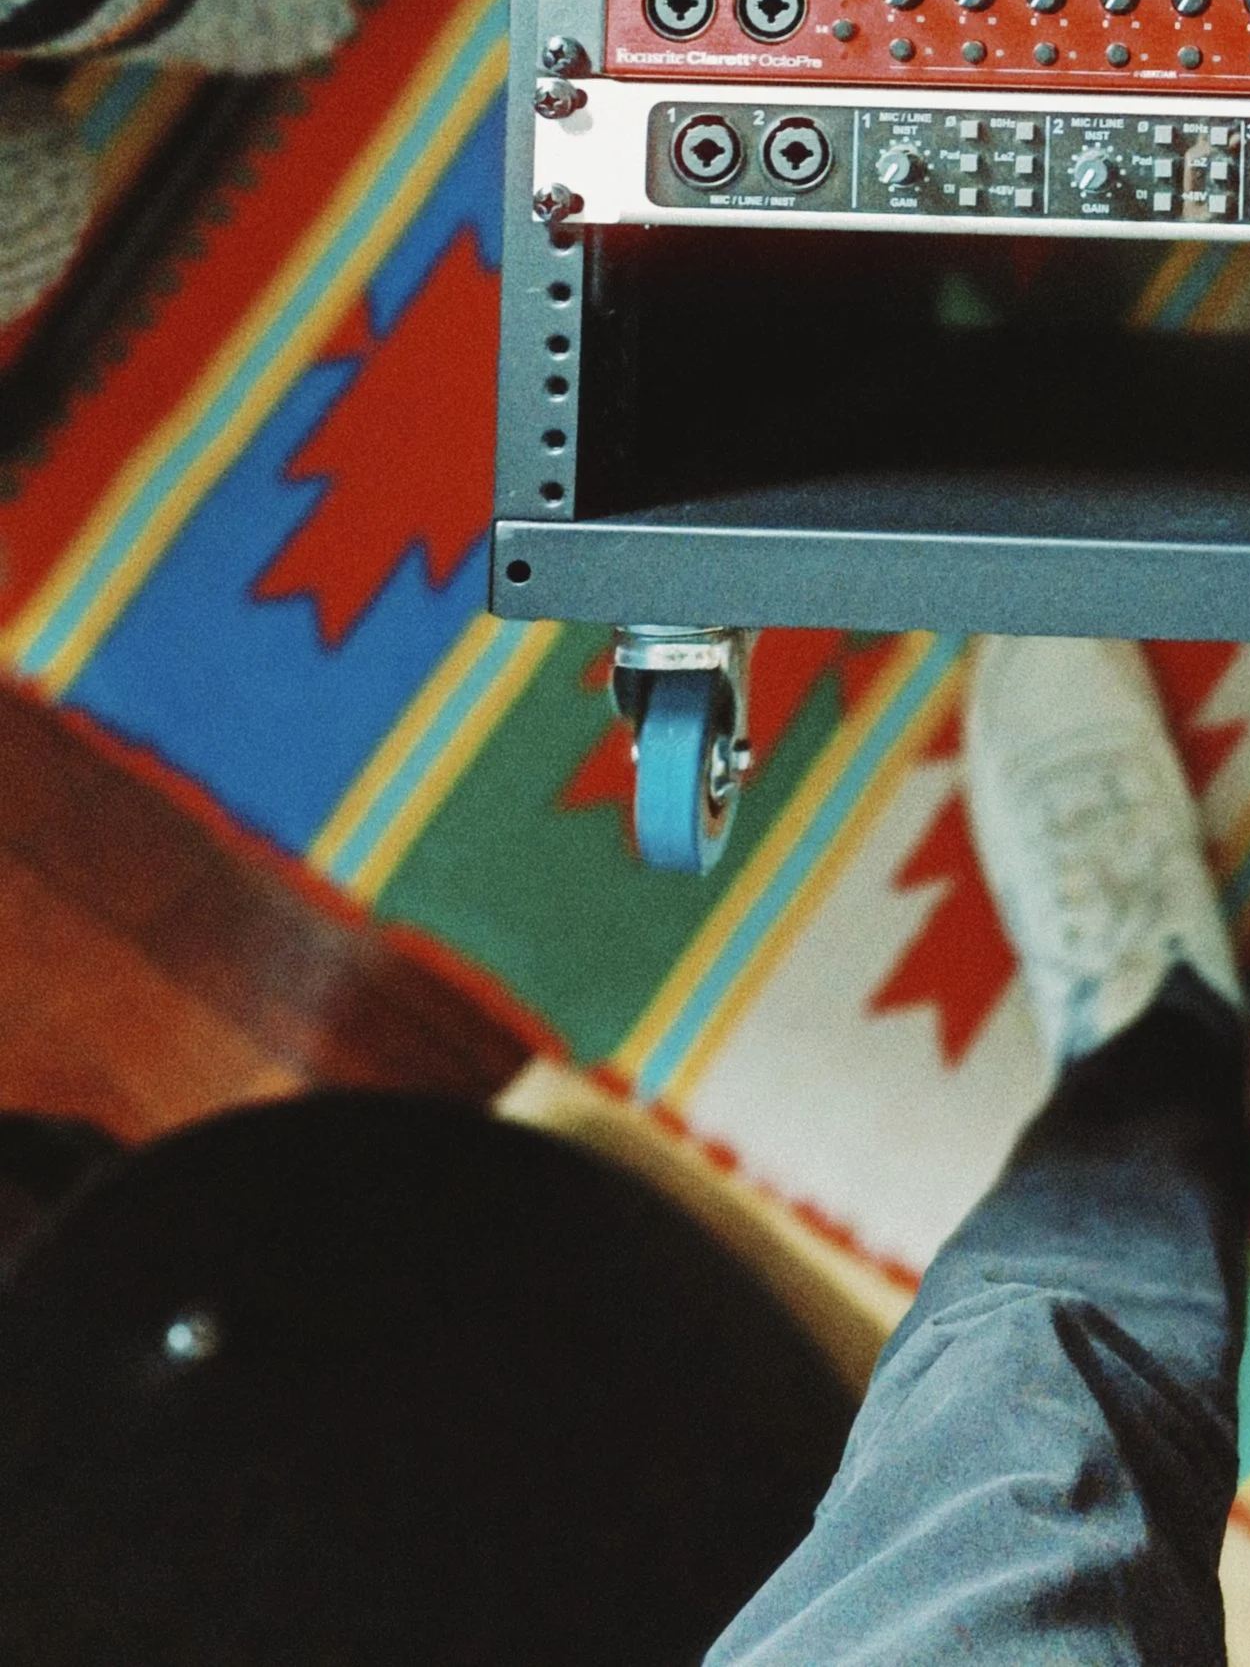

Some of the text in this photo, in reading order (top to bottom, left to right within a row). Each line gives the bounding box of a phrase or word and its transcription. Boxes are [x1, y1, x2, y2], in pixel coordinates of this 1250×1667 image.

[616, 48, 684, 65] Focusrite
[759, 54, 823, 69] OctoPre
[667, 108, 676, 123] 1
[753, 110, 764, 125] 2
[862, 113, 871, 129] 1
[879, 112, 900, 122] MIC
[908, 113, 932, 123] LINE
[1053, 119, 1064, 134] 2
[1071, 118, 1091, 127] MIC
[1100, 119, 1124, 129] LINE
[893, 125, 918, 135] INST
[1085, 131, 1110, 140] INST
[940, 150, 960, 160] Pad
[1132, 156, 1152, 166] Pad
[1136, 189, 1148, 199] DI
[710, 195, 730, 205] MIC
[739, 196, 763, 206] LINE
[770, 196, 796, 206] INST
[890, 198, 917, 207] GAIN
[1082, 203, 1109, 213] GAIN
